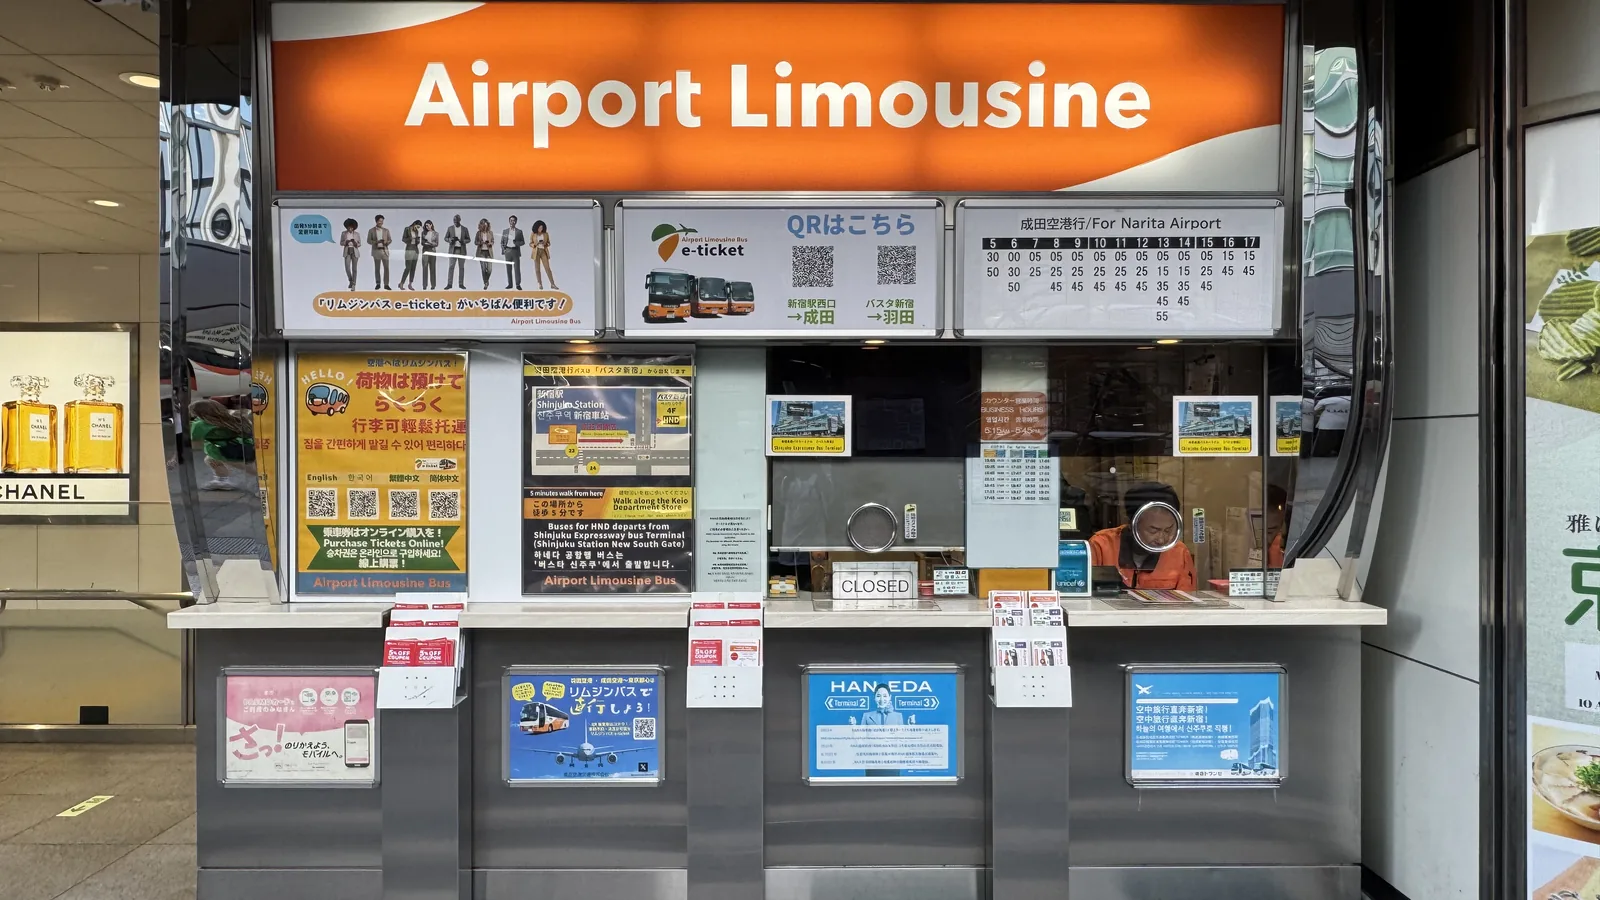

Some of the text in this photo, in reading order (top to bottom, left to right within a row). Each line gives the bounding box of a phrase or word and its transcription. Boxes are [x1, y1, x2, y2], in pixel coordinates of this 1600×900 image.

[404, 59, 1152, 149] Airport Limousine
[787, 213, 916, 239] QRはこちら
[1020, 218, 1222, 231] 成田空港行/For Narita Airport
[989, 237, 1256, 249] 5 6 7 8 9 10 11 12 13 14 15 16 17
[682, 244, 745, 256] e-ticket
[986, 250, 1256, 262] 30 00 05 05 05 05 05 05 05 05 05 15 15
[986, 265, 1255, 278] 50 30 25 25 25 25 25 25 15 15 25 45 45
[1007, 280, 1213, 293] 50 45 45 45 45 45 35 35 45
[788, 299, 836, 308] 新宿駅西口
[866, 299, 914, 308] バスタ新宿
[1156, 295, 1190, 307] 45 45
[803, 309, 835, 325] 成田
[883, 309, 915, 325] 羽田
[1156, 310, 1169, 322] 55
[356, 371, 464, 390] 荷物は預けて
[375, 396, 442, 413] らくらく
[575, 400, 605, 409] Station
[663, 416, 680, 424] HND
[326, 438, 366, 450] 간편하게
[391, 439, 402, 451] 수
[404, 439, 424, 451] 있어
[307, 474, 338, 483] English
[0, 484, 85, 500] HANEL
[613, 504, 660, 512] Department
[634, 498, 655, 506] along
[548, 523, 670, 532] Buses for HND departs from
[533, 531, 685, 540] Shinjuku Expressway bus Terminal
[323, 539, 444, 548] Purchase Tickets Online!
[533, 540, 575, 549] (Shinjuku
[577, 540, 610, 548] Station
[632, 540, 659, 548] South
[661, 540, 685, 549] Gate)
[313, 577, 451, 591] Airport Limousine Bus
[544, 575, 676, 588] Airport Limousine Bus
[842, 579, 910, 594] CLOSED
[1056, 579, 1077, 587] unicef
[834, 698, 866, 707] Terminal 2
[898, 698, 930, 707] Terminal 3
